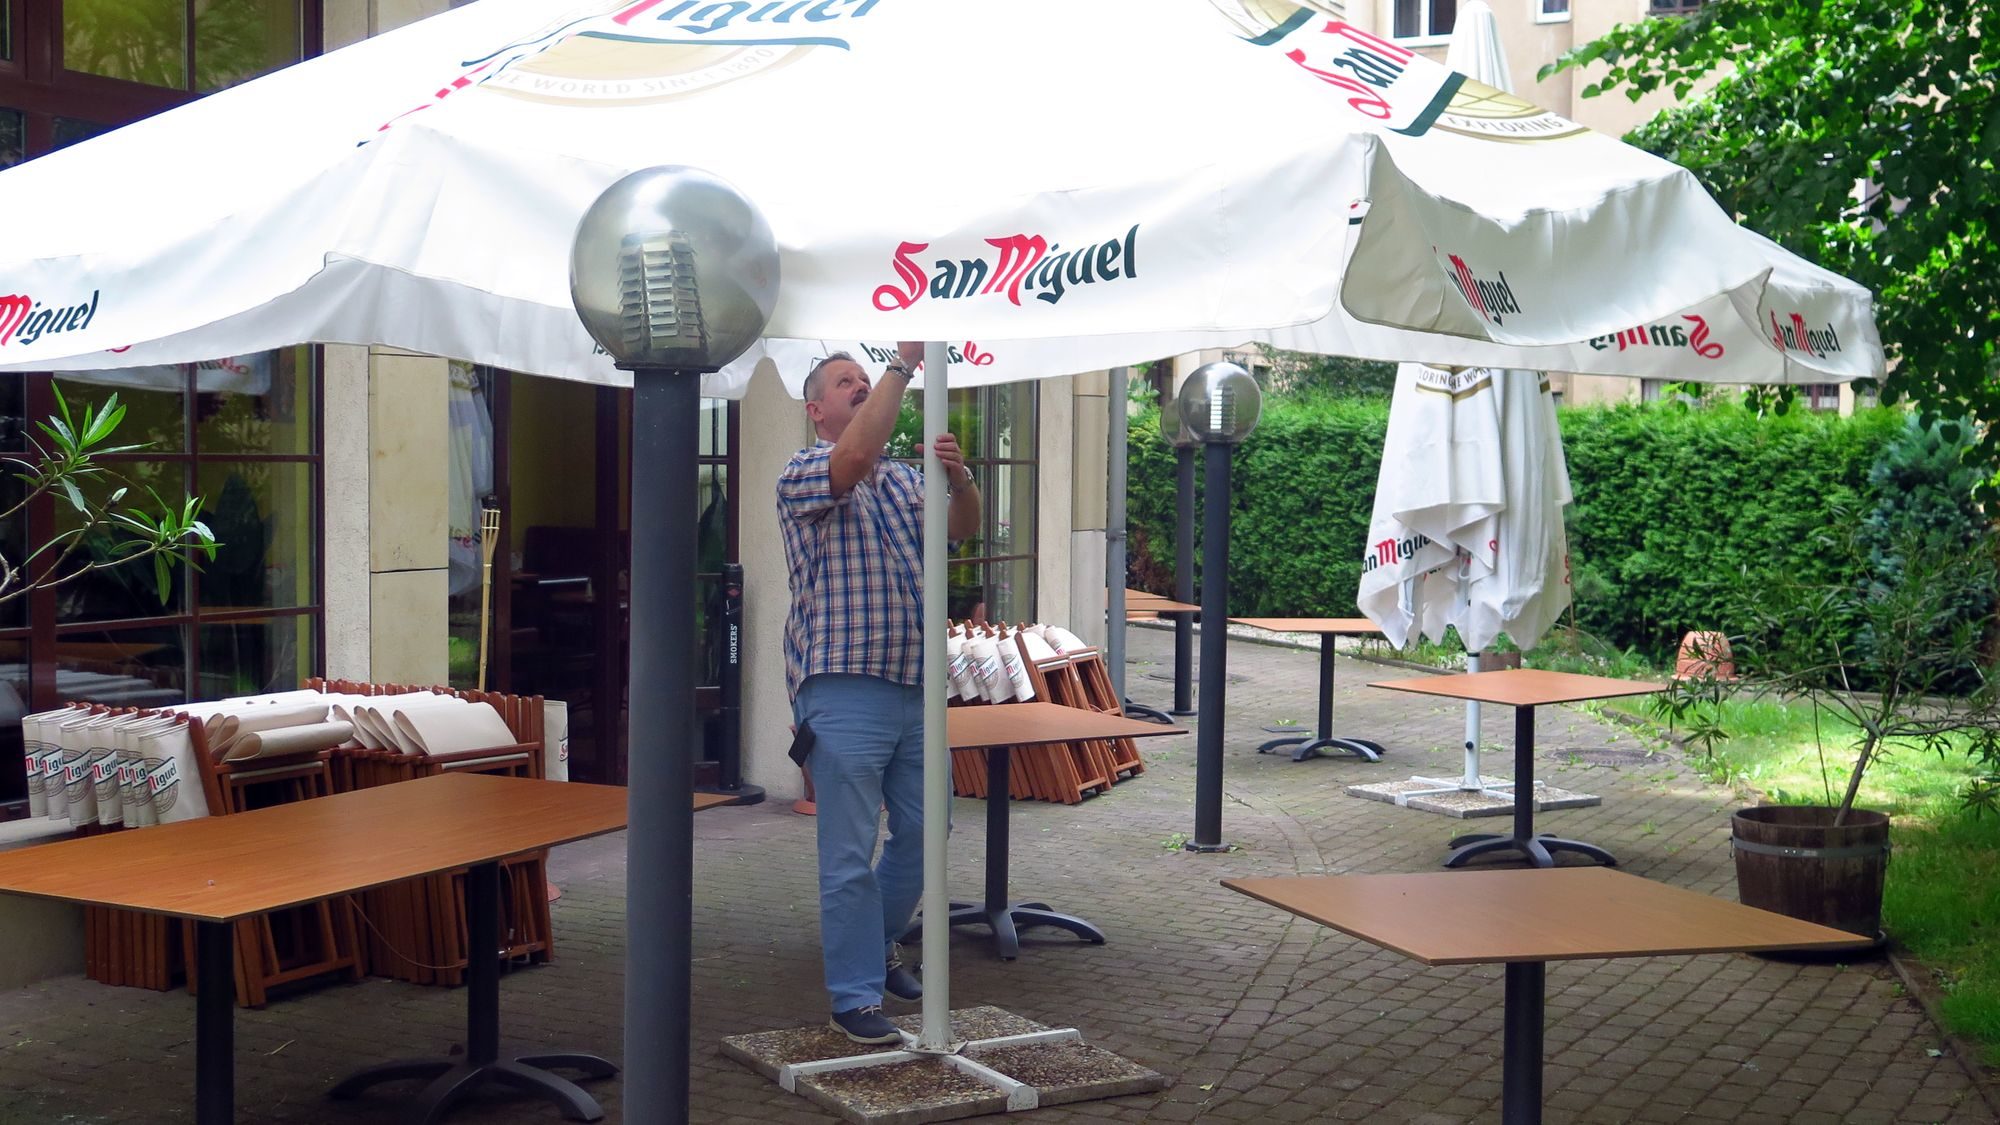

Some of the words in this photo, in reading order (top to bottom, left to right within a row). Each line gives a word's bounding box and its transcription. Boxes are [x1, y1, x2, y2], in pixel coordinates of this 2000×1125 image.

[533, 77, 632, 95] WORLD
[722, 46, 776, 74] 1890
[1447, 115, 1563, 133] EXPLORING
[872, 241, 988, 311] San
[981, 223, 1140, 306] Miguel
[1362, 553, 1377, 574] an
